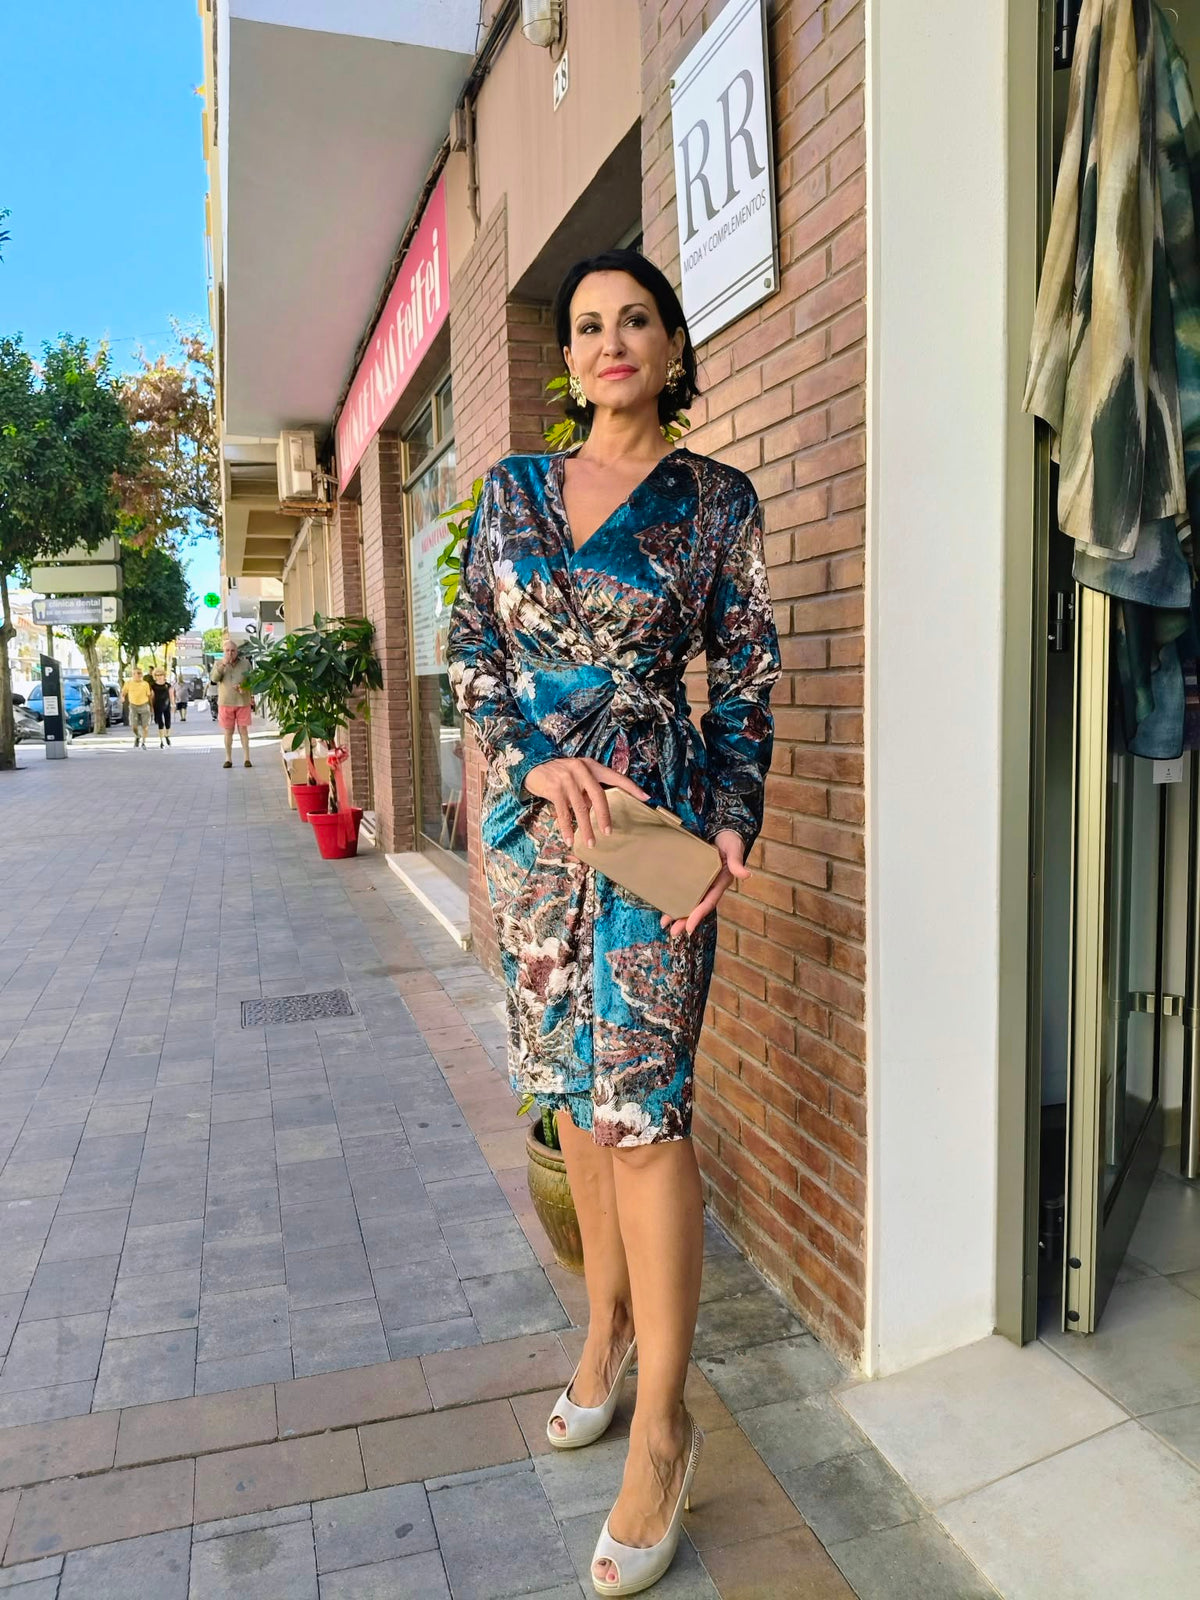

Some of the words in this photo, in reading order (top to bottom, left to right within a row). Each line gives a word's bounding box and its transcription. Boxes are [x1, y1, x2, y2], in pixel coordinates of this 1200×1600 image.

[555, 57, 567, 107] 18
[678, 68, 765, 246] RR
[683, 247, 703, 273] MODA
[702, 240, 708, 256] Y
[708, 188, 767, 252] COMPLEMENTOS
[396, 226, 441, 375] FeiFei
[75, 598, 101, 607] dental
[44, 666, 53, 677] P
